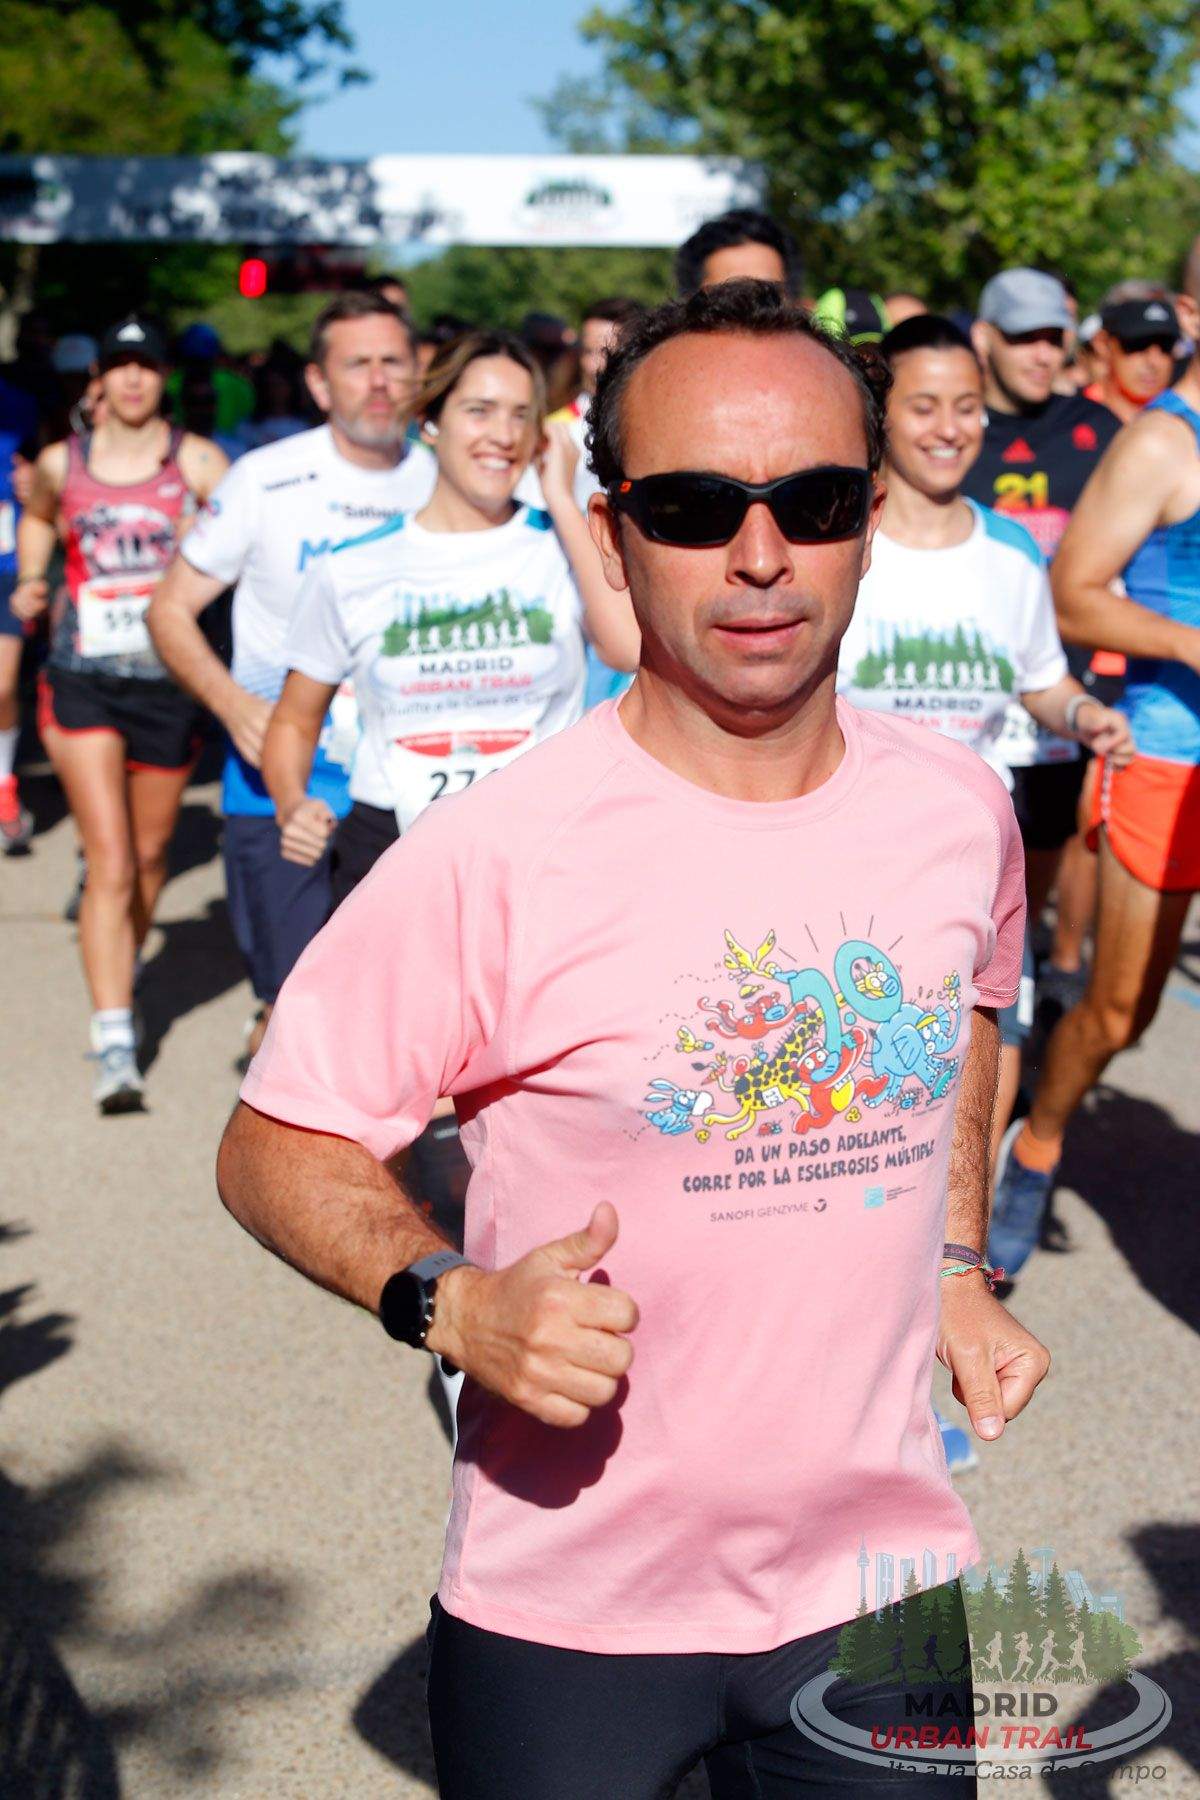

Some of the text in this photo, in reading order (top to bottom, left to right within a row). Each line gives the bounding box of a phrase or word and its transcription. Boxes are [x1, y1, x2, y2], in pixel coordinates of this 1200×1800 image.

[993, 471, 1049, 511] 21
[419, 656, 515, 674] MADRID
[894, 696, 982, 712] MADRID
[429, 769, 500, 802] 27
[735, 1125, 907, 1165] DA UN PASO ADELANTE,
[682, 1174, 732, 1193] CORRE
[738, 1170, 767, 1190] POR
[773, 1166, 791, 1185] LA
[797, 1155, 880, 1182] ESCLEROSIS
[710, 1201, 810, 1223] SANOFI GENZYME
